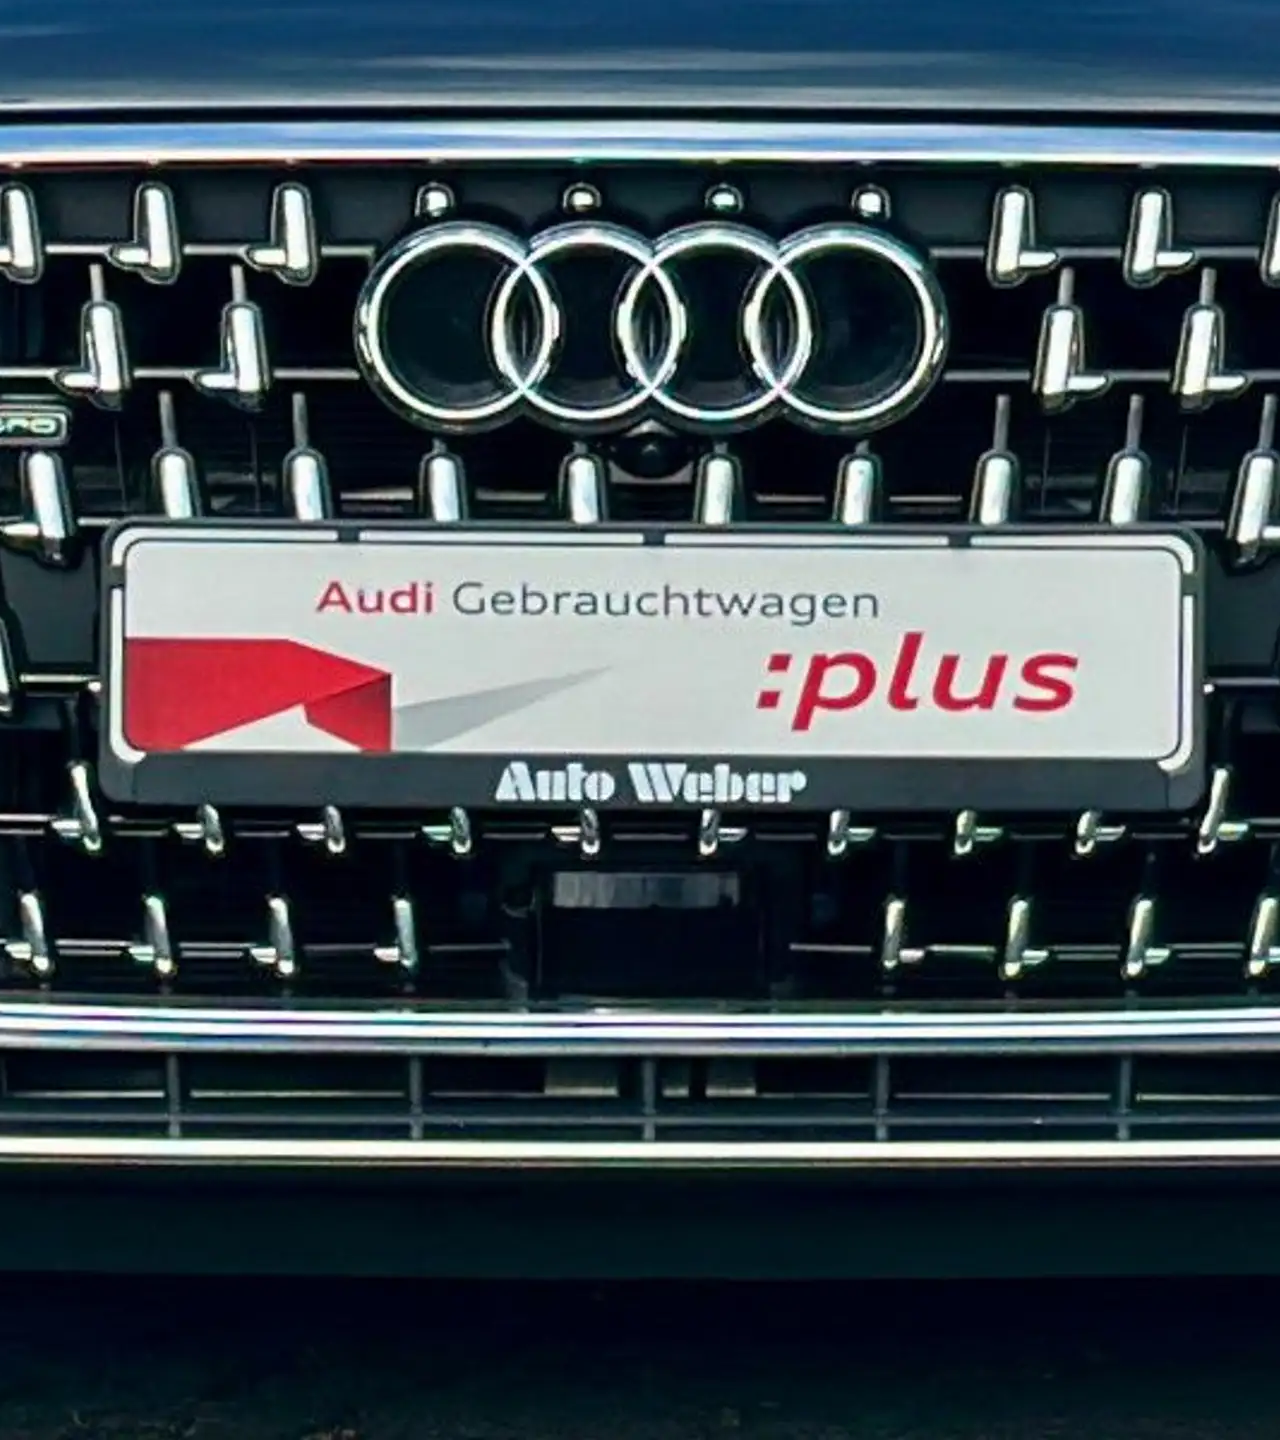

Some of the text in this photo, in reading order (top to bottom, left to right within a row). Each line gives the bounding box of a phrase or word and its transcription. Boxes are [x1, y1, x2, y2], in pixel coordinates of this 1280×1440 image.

[317, 580, 879, 626] Audi Gebrauchtwagen
[757, 632, 1078, 730] :plus
[495, 762, 807, 803] Auto Weber
